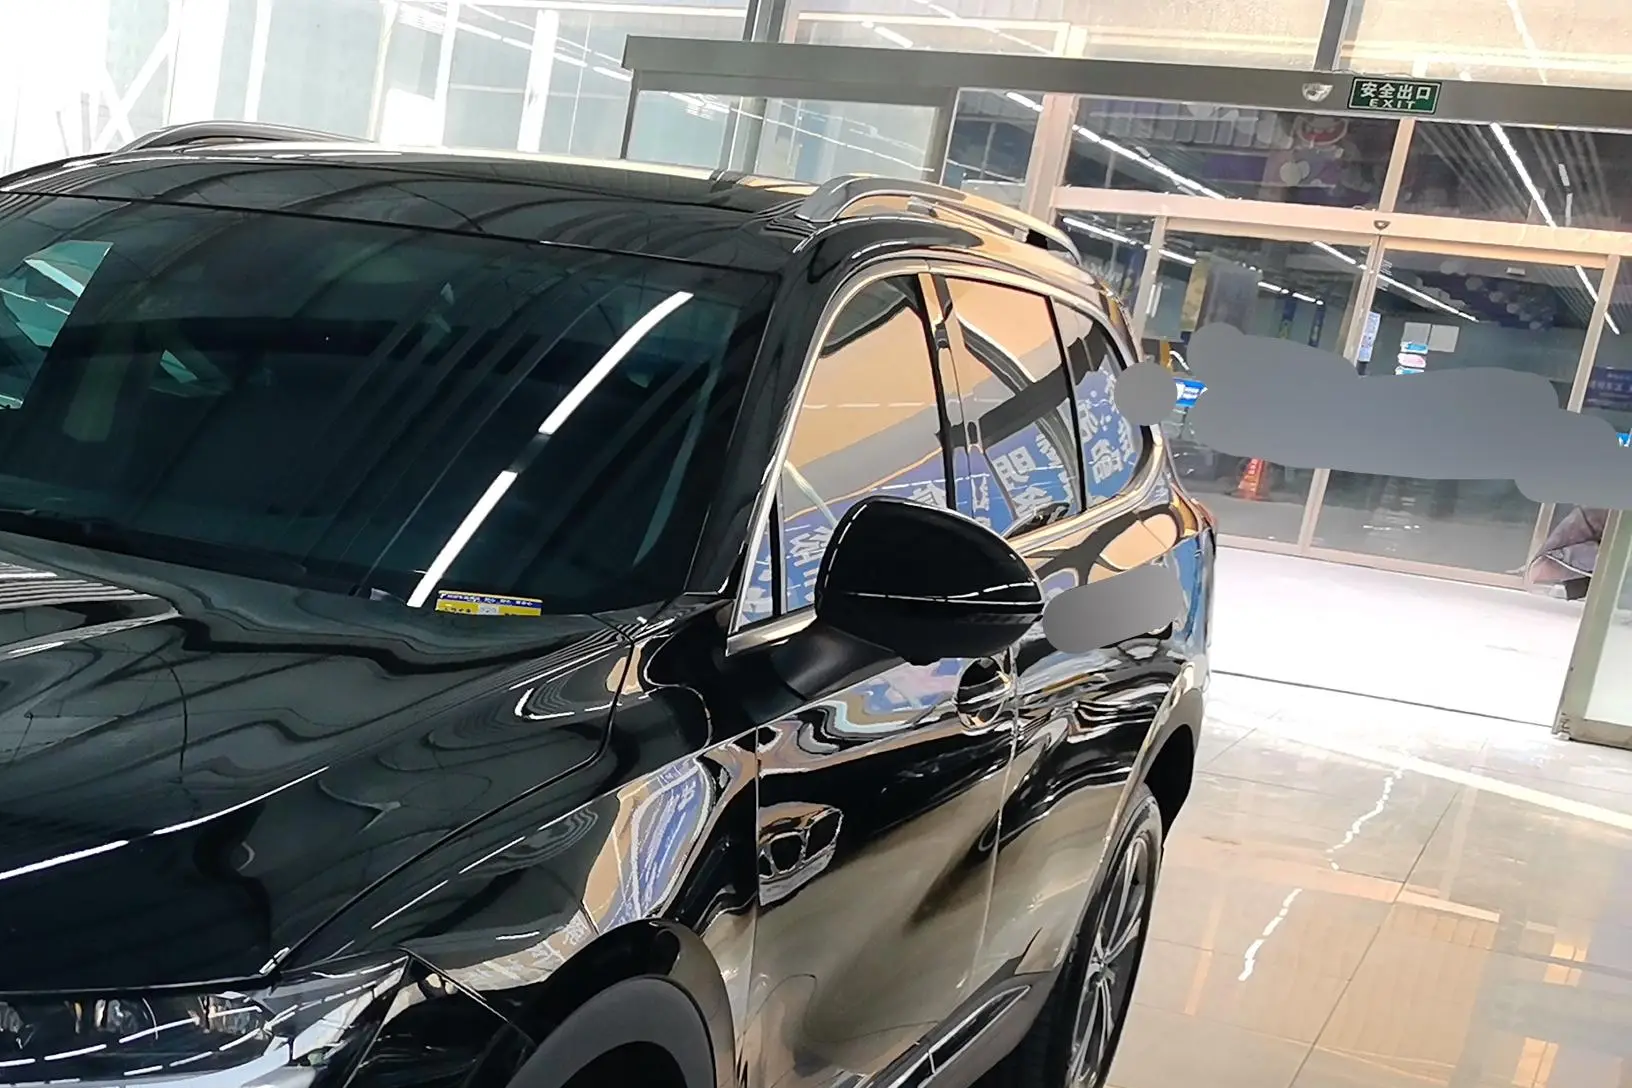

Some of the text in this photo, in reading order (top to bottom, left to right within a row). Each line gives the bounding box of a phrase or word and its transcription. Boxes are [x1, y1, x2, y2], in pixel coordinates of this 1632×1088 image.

[1360, 81, 1432, 100] 安全出口
[1368, 99, 1416, 109] EXIT
